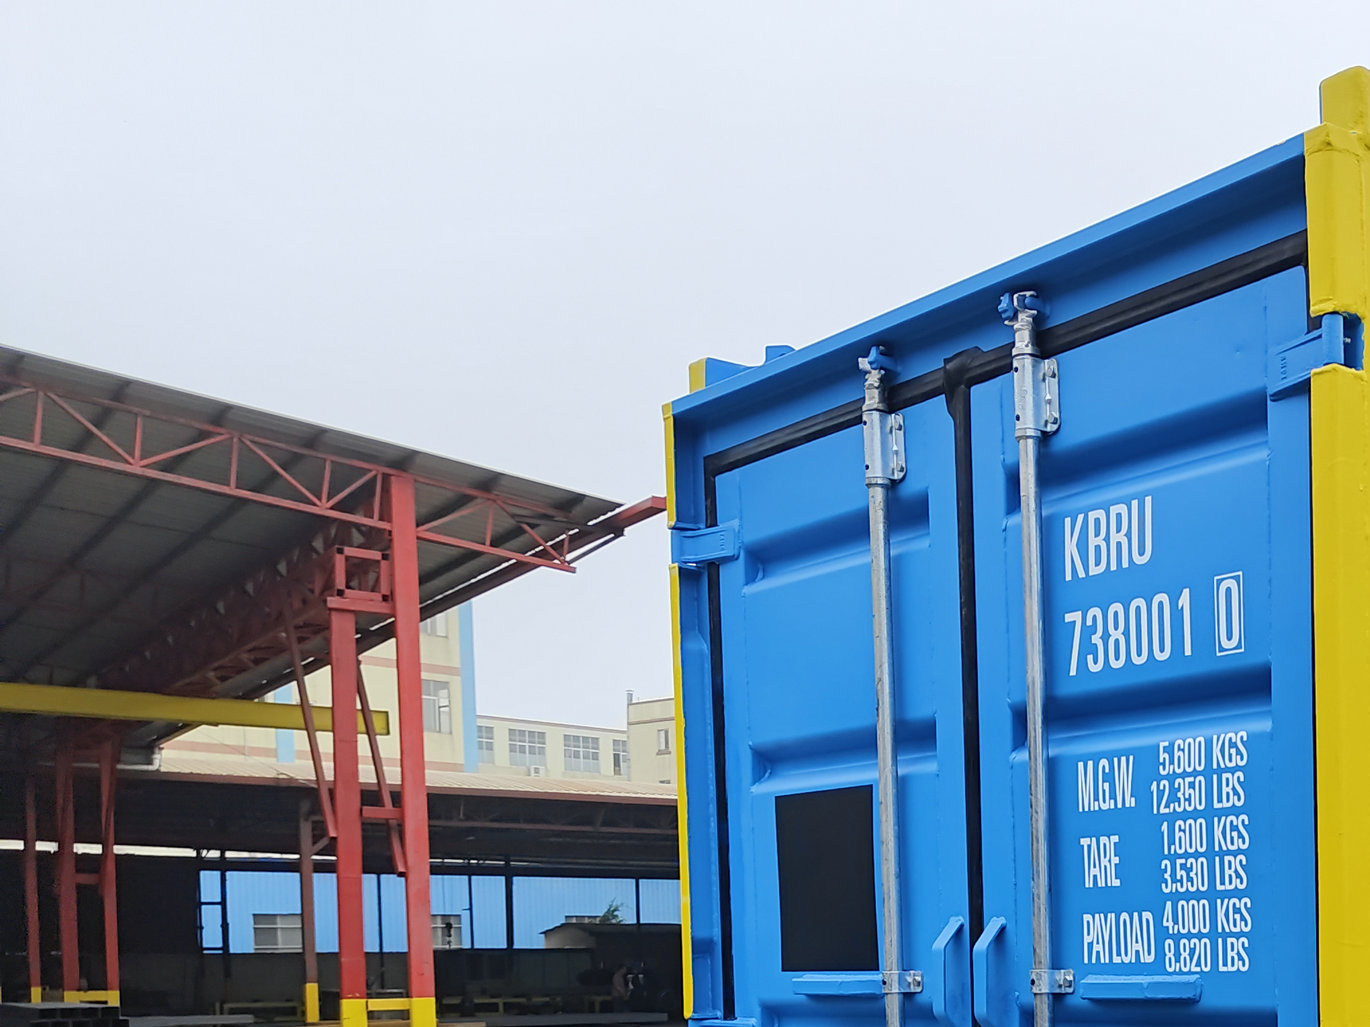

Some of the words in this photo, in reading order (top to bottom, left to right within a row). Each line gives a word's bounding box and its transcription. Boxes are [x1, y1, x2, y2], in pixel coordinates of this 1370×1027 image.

[1064, 495, 1152, 581] KBRU
[1064, 588, 1192, 676] 738001
[1217, 576, 1241, 651] 0
[1158, 736, 1205, 775] 5,600
[1212, 731, 1248, 770] KGS
[1077, 755, 1136, 812] M.G.W.
[1150, 775, 1206, 814] 12,350
[1212, 771, 1245, 809] LBS
[1161, 817, 1207, 855] 1,600
[1213, 814, 1250, 852] KGS
[1080, 835, 1121, 888] TARE
[1161, 856, 1209, 893] 3,530
[1215, 854, 1247, 891] LBS
[1082, 911, 1156, 964] PAYLOAD
[1162, 898, 1210, 935] 4,000
[1216, 897, 1252, 933] KGS
[1164, 937, 1211, 972] 8,820
[1217, 936, 1249, 972] LBS
